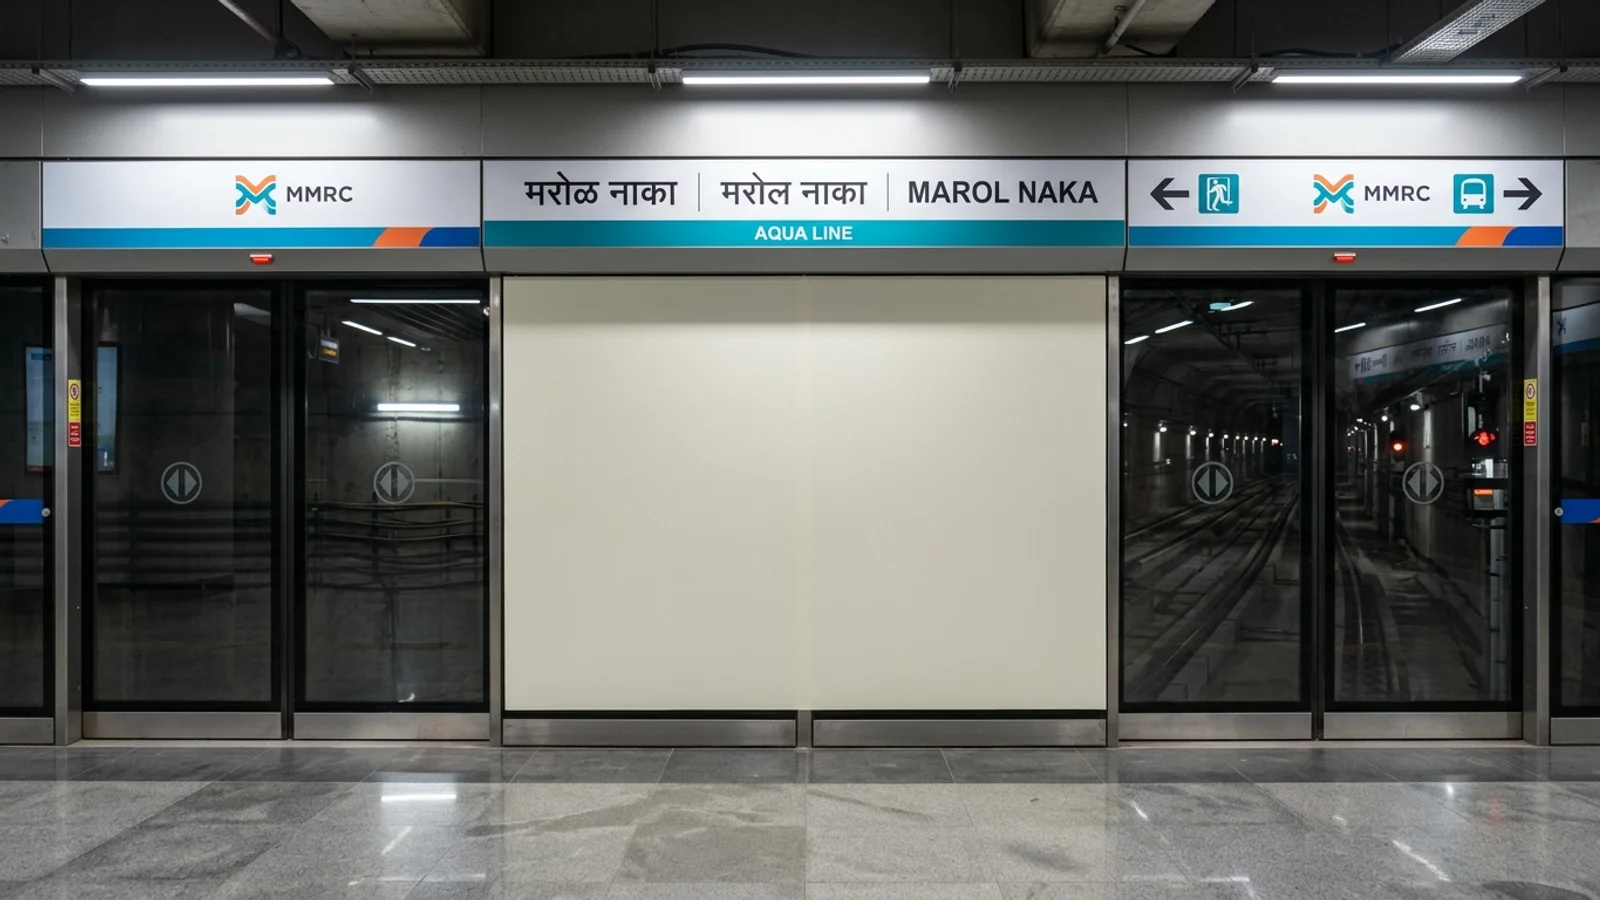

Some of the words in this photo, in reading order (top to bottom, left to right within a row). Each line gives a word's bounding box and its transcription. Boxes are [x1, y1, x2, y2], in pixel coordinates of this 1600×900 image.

[286, 185, 353, 203] MMRC
[523, 170, 600, 206] मरोळ
[608, 181, 679, 206] नाका
[720, 172, 791, 205] मरोल
[801, 181, 868, 205] नाका
[908, 180, 1010, 204] MAROL
[1018, 180, 1100, 204] NAKA
[1364, 185, 1431, 202] MMRC
[754, 225, 808, 242] AQUA
[812, 225, 853, 241] LINE
